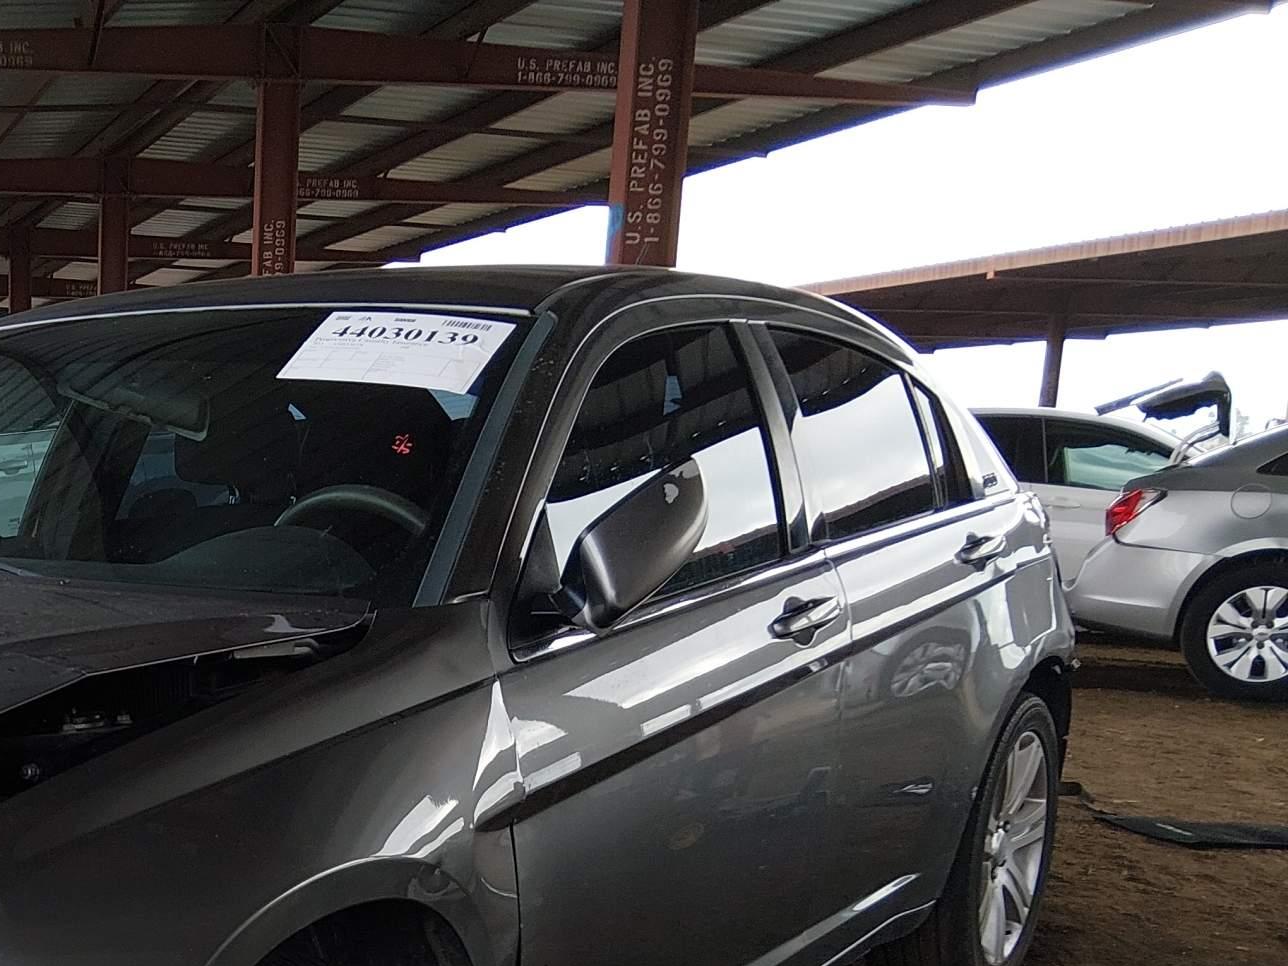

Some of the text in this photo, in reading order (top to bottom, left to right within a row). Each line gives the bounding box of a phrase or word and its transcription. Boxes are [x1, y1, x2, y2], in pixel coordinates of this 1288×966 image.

[517, 57, 618, 74] U.S. PREFAB INC.
[517, 71, 617, 86] 1-866-799-0969
[625, 56, 657, 245] U.S. PREFAB INC.
[644, 58, 674, 243] 1-866-799-0969
[262, 219, 275, 277] FAB INC.
[332, 325, 479, 345] 44030139
